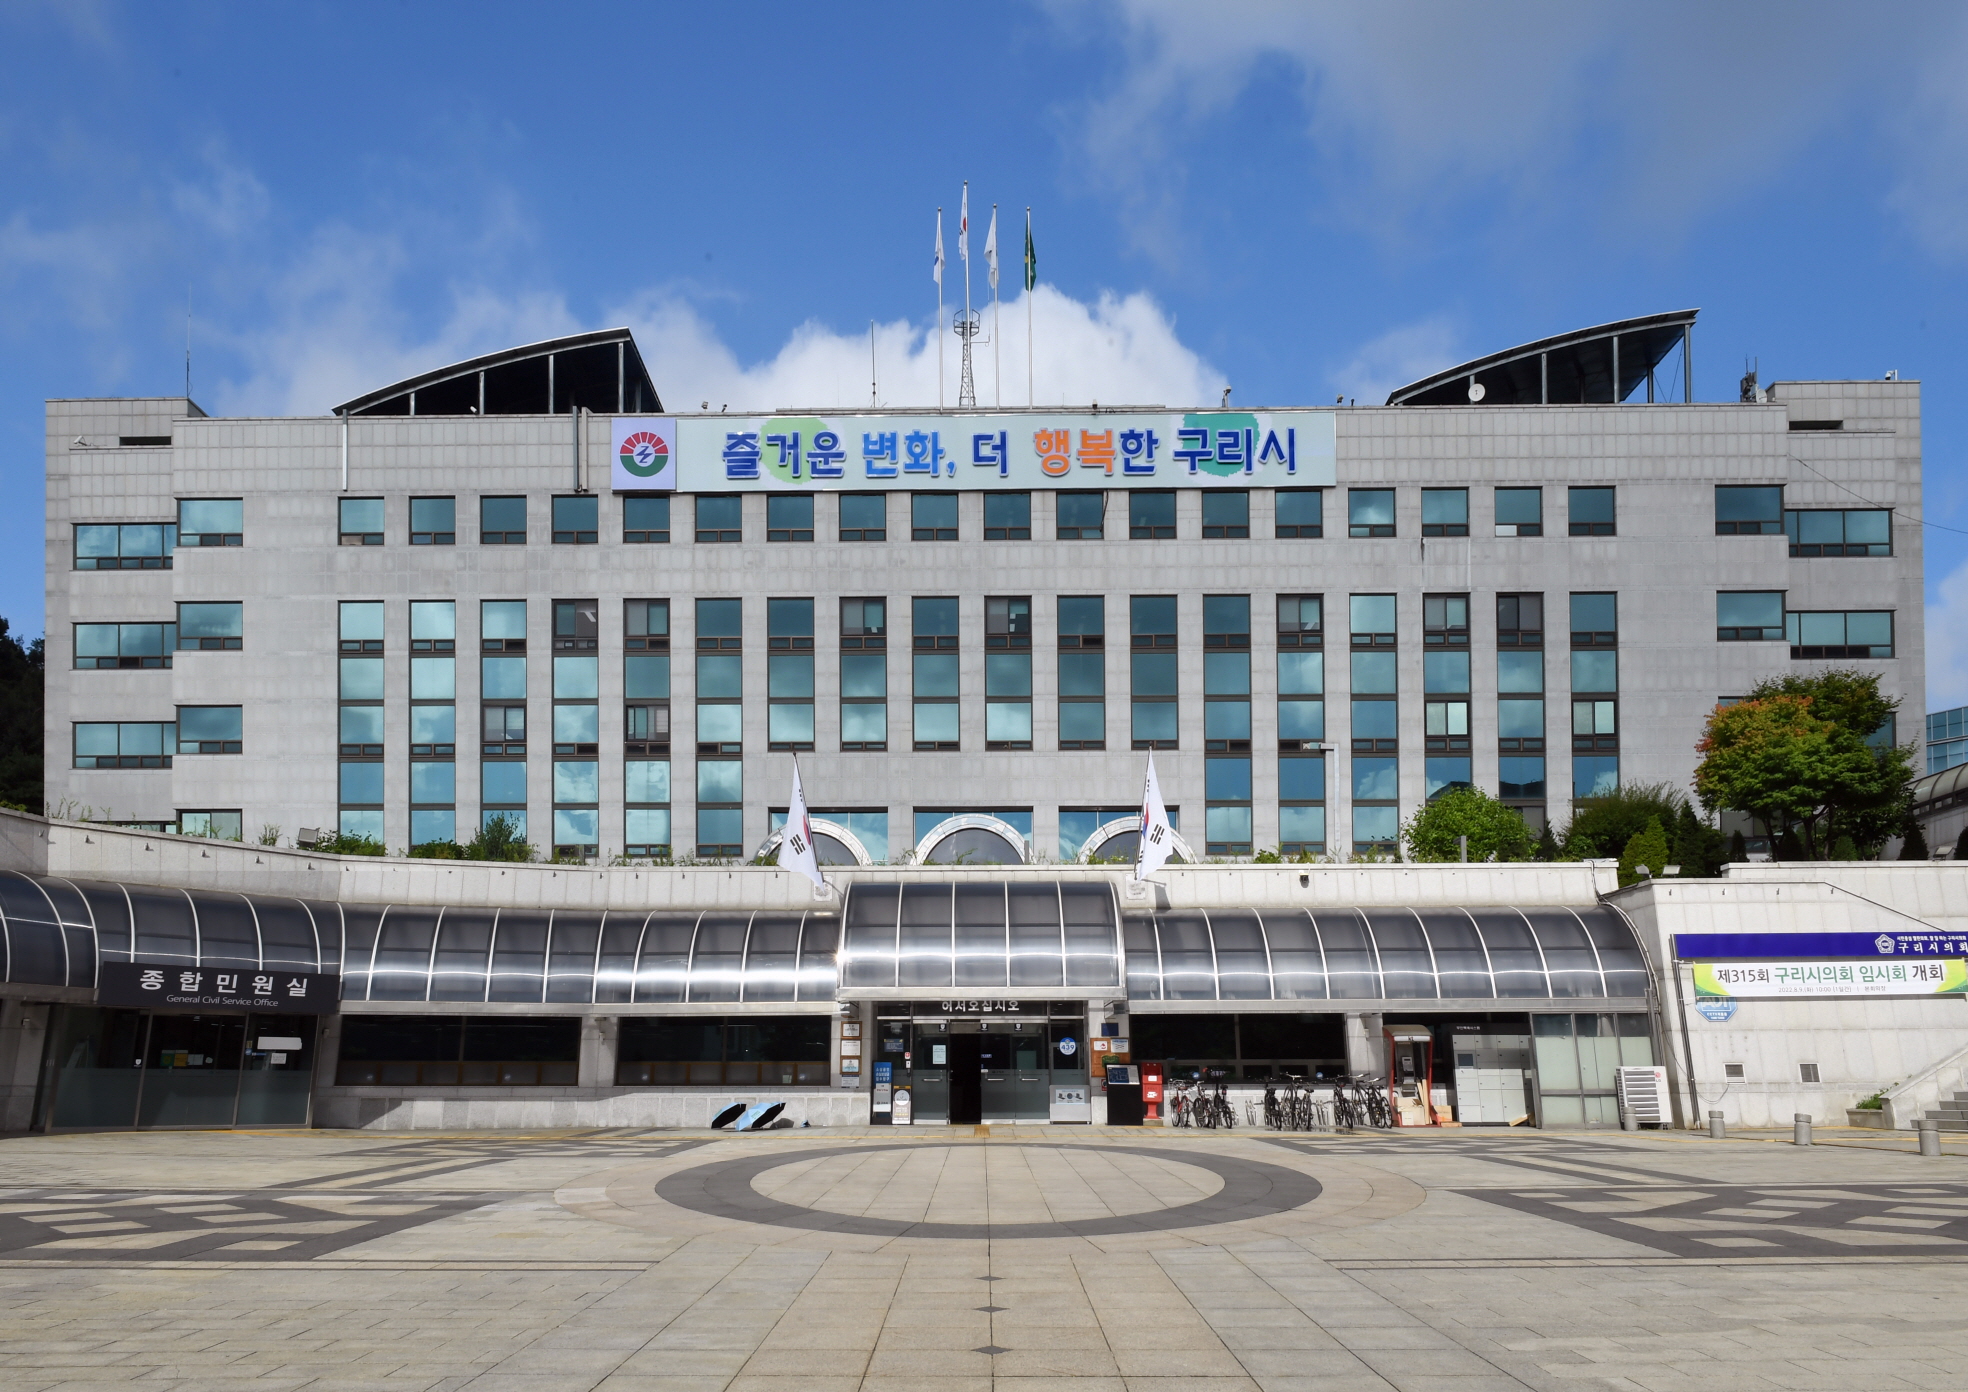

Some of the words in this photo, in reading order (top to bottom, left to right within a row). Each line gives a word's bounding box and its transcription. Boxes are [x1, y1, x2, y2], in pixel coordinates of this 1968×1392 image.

[722, 431, 846, 479] 즐거운
[862, 430, 957, 477] 변화,
[972, 429, 1009, 477] 더
[1033, 428, 1160, 476] 행복한
[1173, 427, 1297, 475] 구리시
[1898, 942, 1968, 954] 구리시의회
[1717, 969, 1769, 983] 제315회
[1774, 966, 1854, 983] 구리시의회
[1859, 965, 1907, 982] 임시회
[1912, 964, 1944, 982] 개회
[140, 969, 308, 997] 종합민원실
[166, 995, 200, 1004] General
[202, 996, 220, 1005] Civil
[222, 997, 252, 1006] Service
[254, 998, 279, 1007] Office
[942, 1000, 1020, 1012] 어서오십시오
